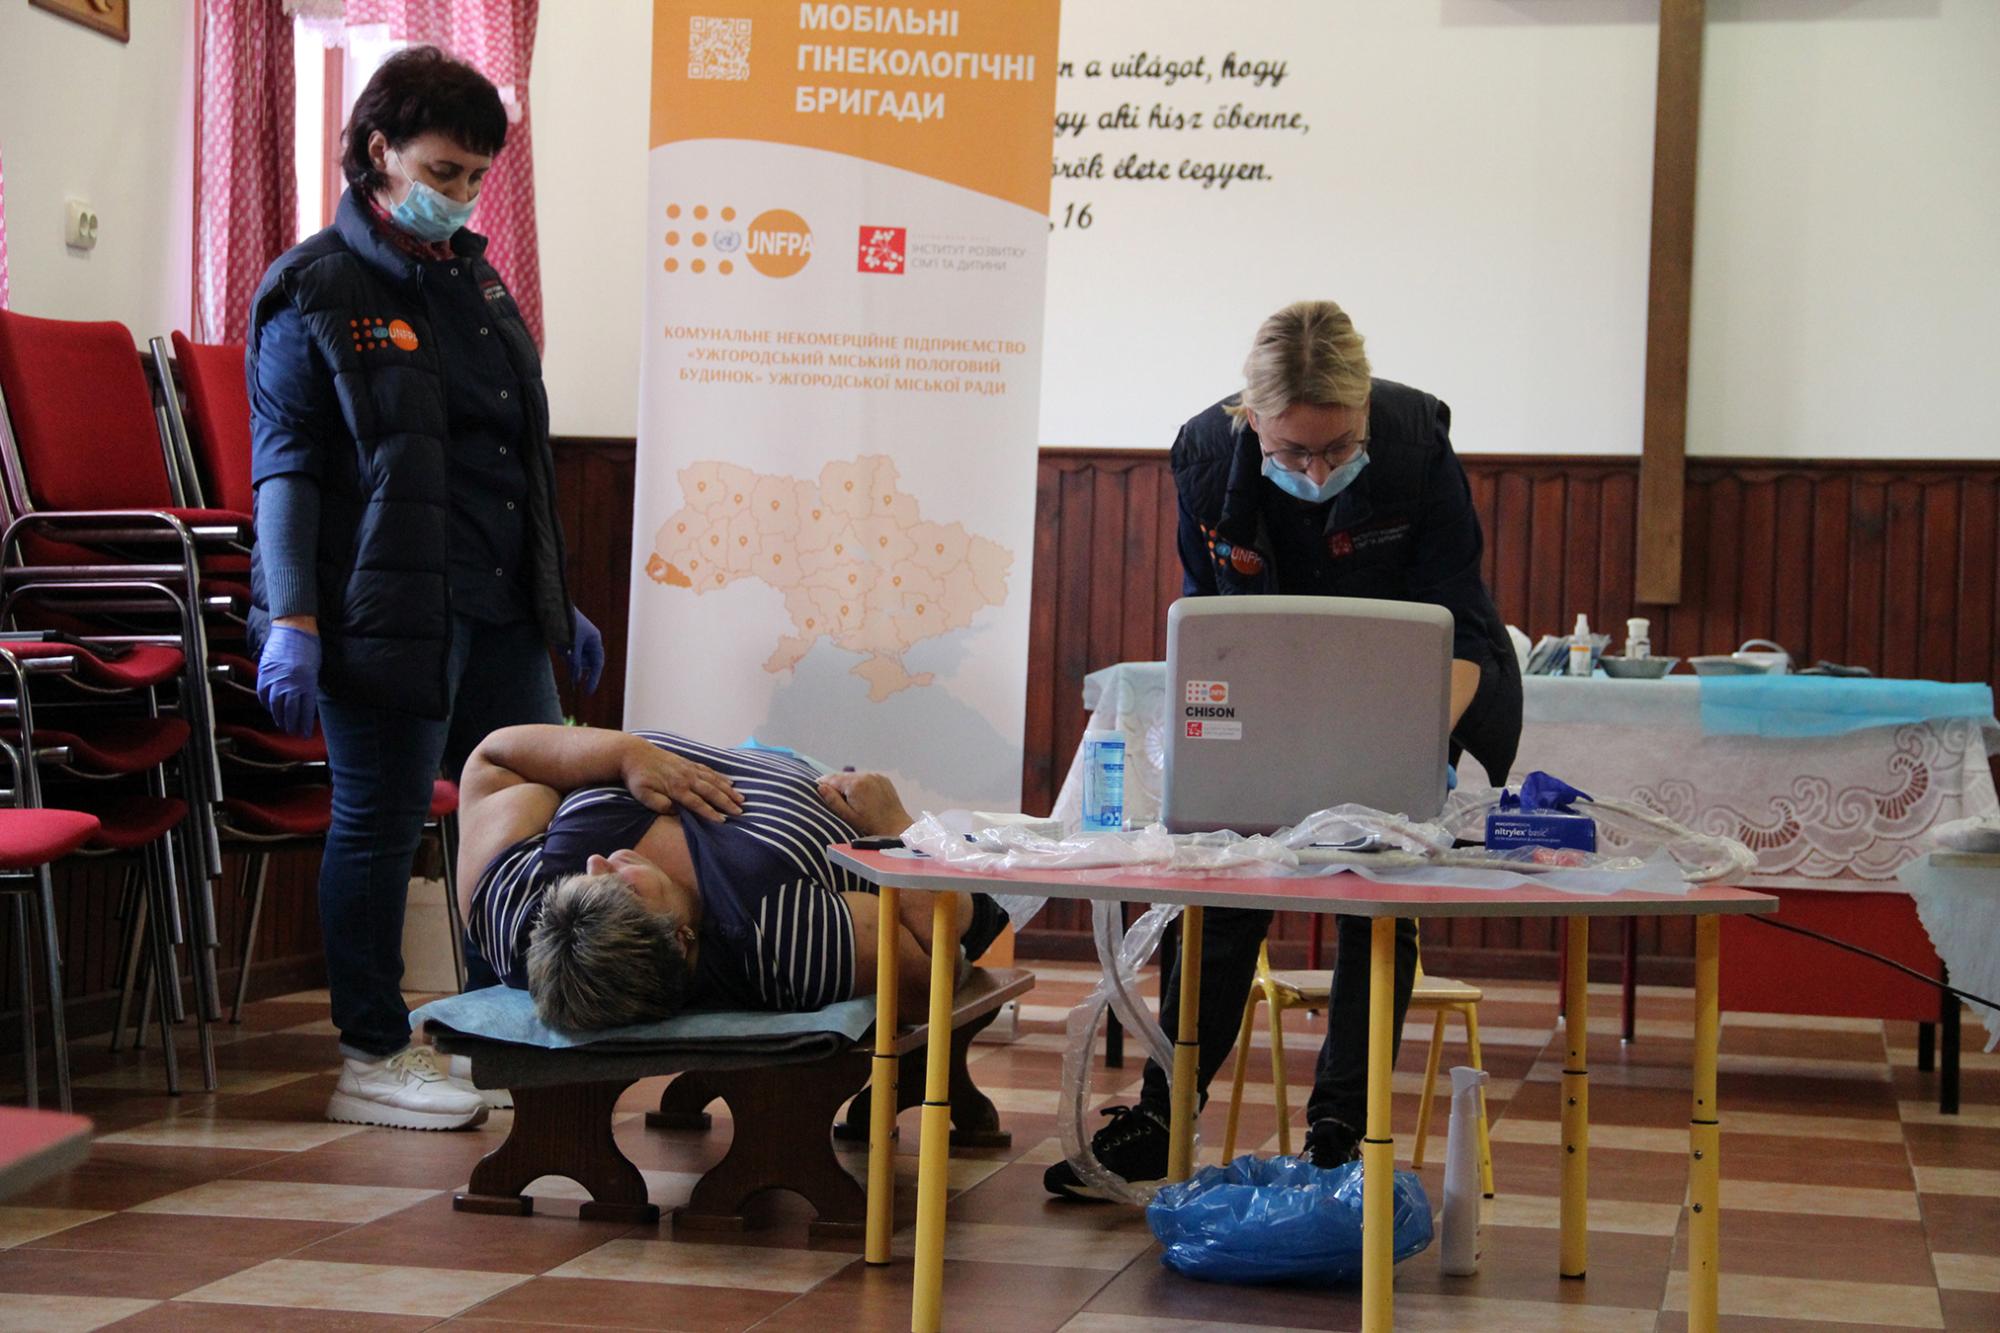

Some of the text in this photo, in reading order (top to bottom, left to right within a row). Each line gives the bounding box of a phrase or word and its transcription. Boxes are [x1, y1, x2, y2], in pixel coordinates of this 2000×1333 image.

[799, 2, 960, 36] МОБІЛЬНІ
[797, 44, 1036, 81] ГІНЕКОЛОГІЧНІ
[1085, 61, 1102, 78] a
[1111, 51, 1213, 87] világot,
[1221, 51, 1289, 87] hogy
[795, 86, 945, 123] БРИГАДИ
[1054, 111, 1089, 138] gy
[1113, 153, 1171, 180] élete
[1178, 159, 1273, 190] legyen.
[1064, 202, 1093, 229] 16
[745, 229, 815, 257] UNFPA
[664, 325, 771, 344] КОМУНАЛЬНЕ
[904, 336, 1026, 355] ПІДПРИЄМСТВО
[829, 352, 900, 370] МІСЬКИЙ
[906, 356, 1001, 374] ПОЛОГОВИЙ
[769, 371, 890, 390] УЖГОРОДСЬКОЇ
[895, 376, 961, 394] МІСЬКОЇ
[964, 380, 1006, 397] РАДИ
[1185, 706, 1235, 718] CHISON
